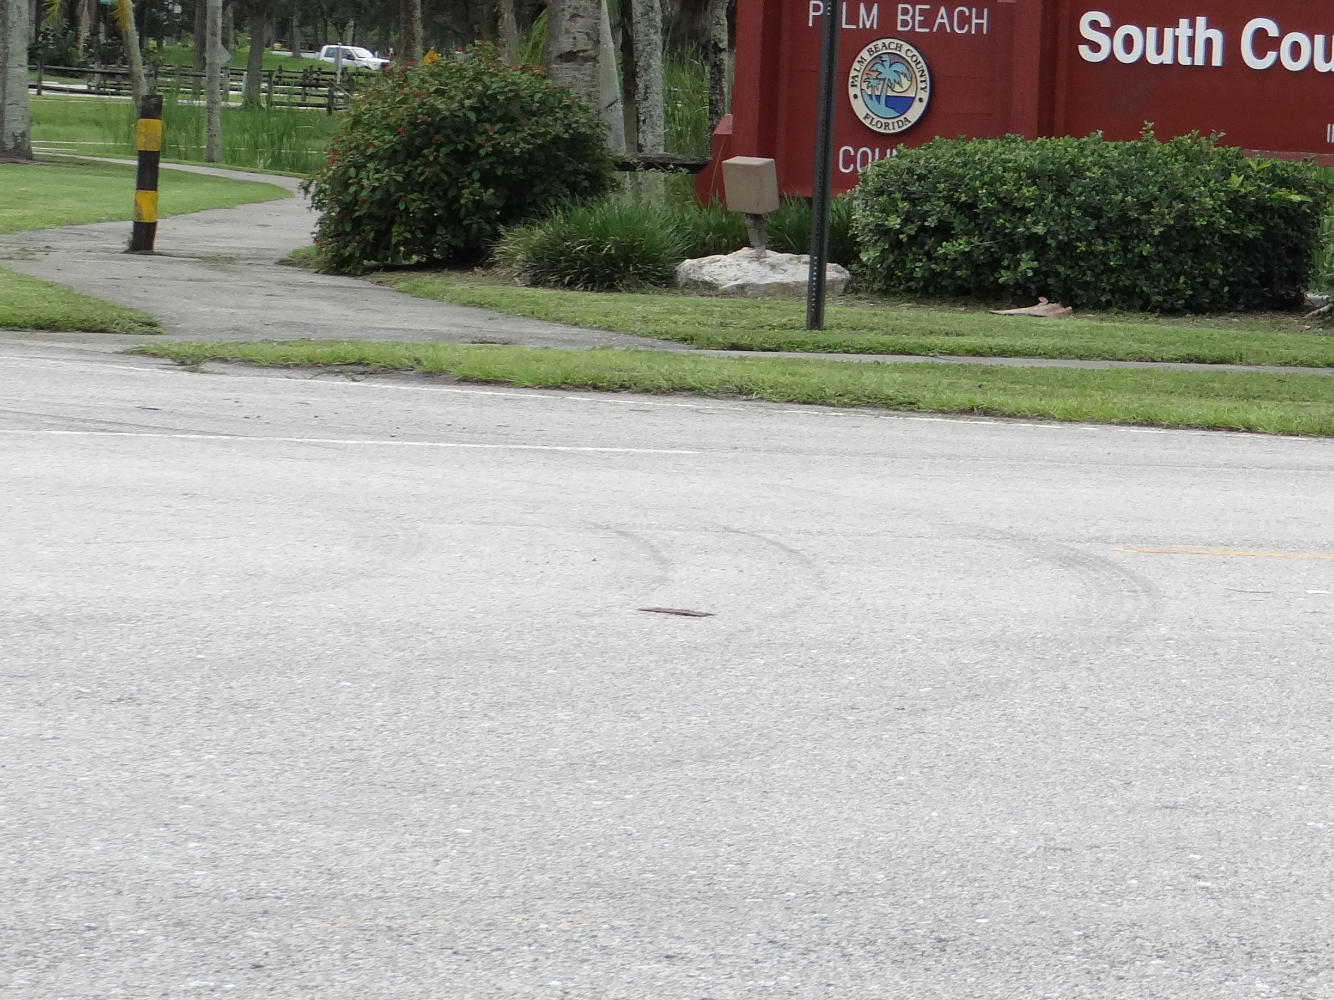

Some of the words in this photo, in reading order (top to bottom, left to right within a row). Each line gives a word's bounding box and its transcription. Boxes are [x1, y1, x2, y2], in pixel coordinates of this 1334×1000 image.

[808, 0, 879, 30] PLM
[896, 3, 988, 35] BEACH
[1078, 10, 1224, 67] South
[850, 55, 869, 88] PALM
[866, 41, 904, 57] BEACH
[905, 48, 928, 93] COUNTY
[862, 113, 912, 131] FLORIDA
